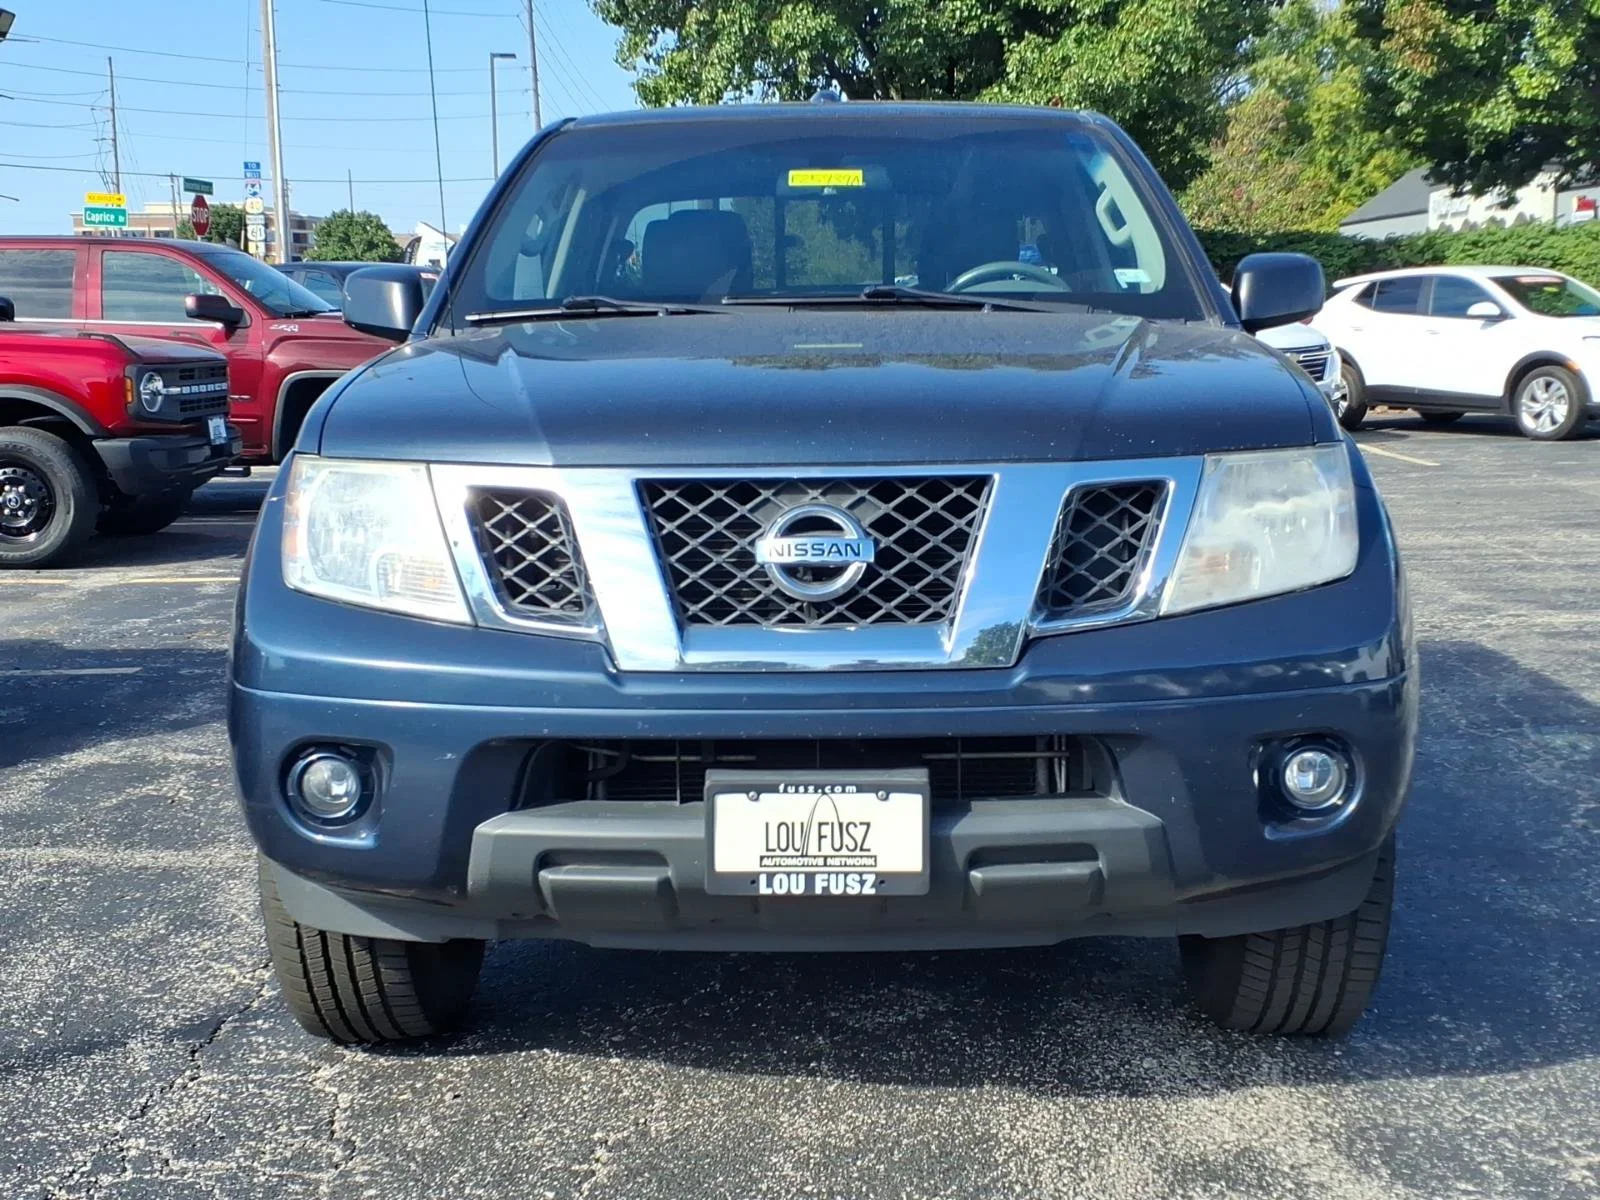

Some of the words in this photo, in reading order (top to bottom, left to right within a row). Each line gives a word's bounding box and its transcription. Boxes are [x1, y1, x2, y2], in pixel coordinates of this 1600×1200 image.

[86, 210, 115, 224] Caprice
[118, 215, 125, 223] Dr
[191, 207, 209, 224] STOP
[251, 227, 262, 238] 61
[181, 382, 228, 394] BRONCO
[768, 543, 861, 557] NISSAN
[778, 783, 857, 794] fusz.com
[765, 821, 805, 853] LOU
[817, 821, 871, 853] FUSZ
[761, 856, 825, 867] AUTOMOTIVE
[826, 856, 876, 867] NETWORK
[759, 873, 806, 895] LOU
[814, 873, 876, 895] FUSZ
